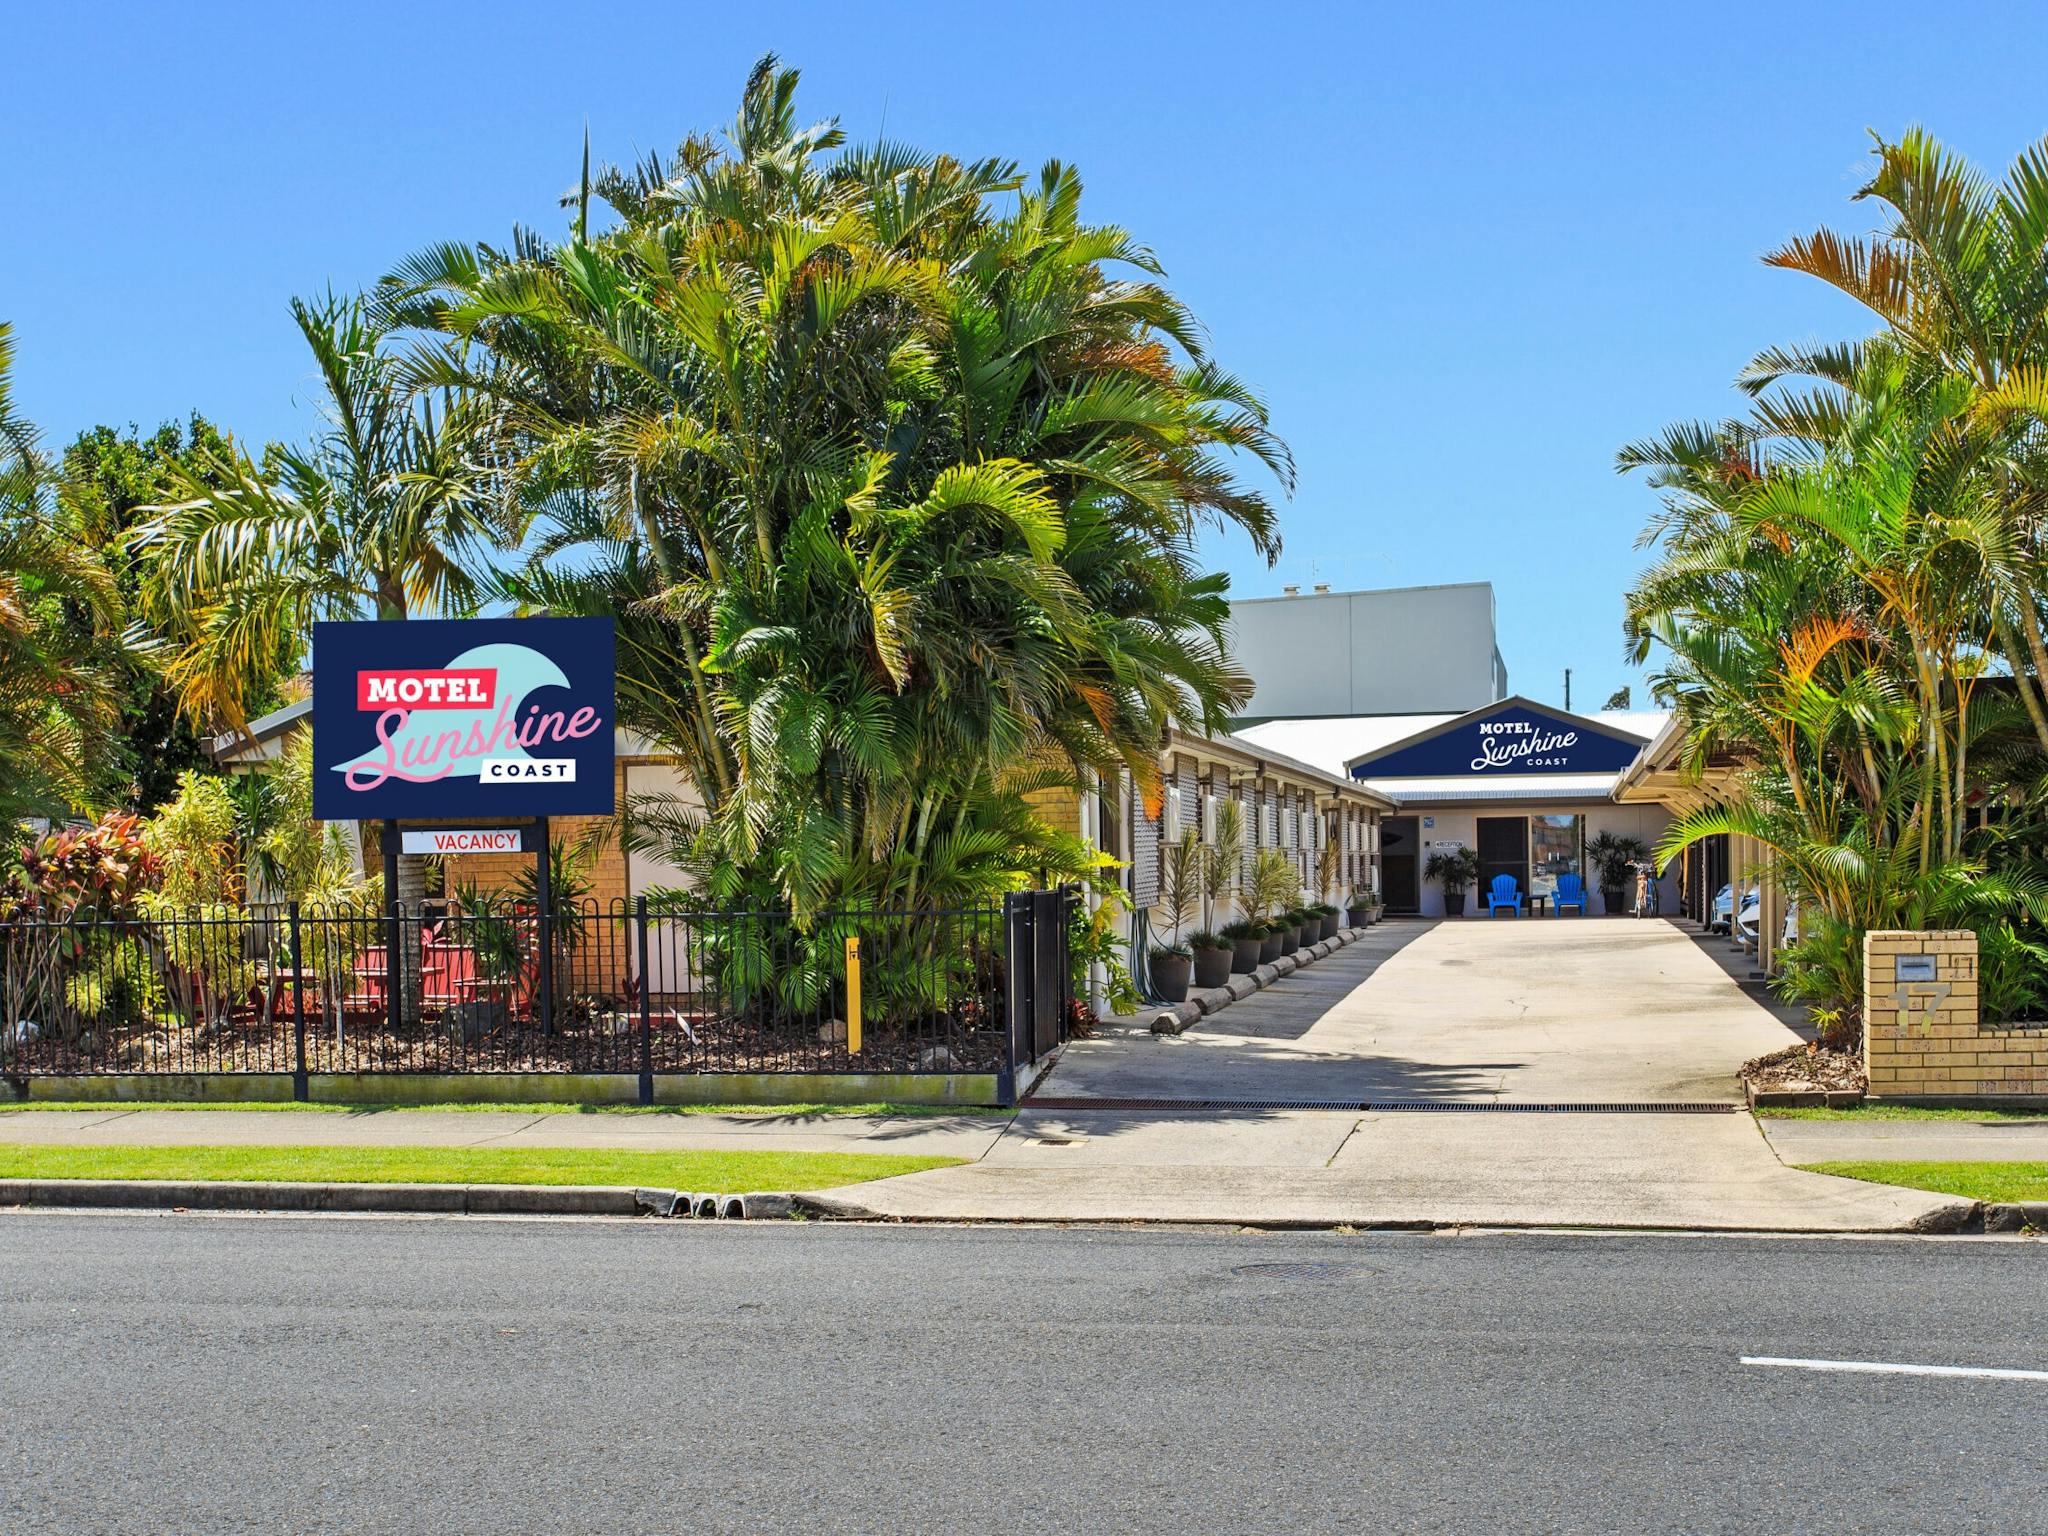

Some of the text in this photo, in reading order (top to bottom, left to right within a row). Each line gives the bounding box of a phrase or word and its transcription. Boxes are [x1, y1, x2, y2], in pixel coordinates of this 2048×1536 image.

[367, 678, 487, 703] MOTEL
[1479, 722, 1532, 735] MOTEL
[345, 694, 602, 792] Sunshine
[1471, 728, 1578, 771] Sunshine
[490, 764, 567, 777] COAST
[1526, 757, 1568, 766] COAST
[434, 833, 517, 850] VACANCY
[1888, 984, 1952, 1038] 17
